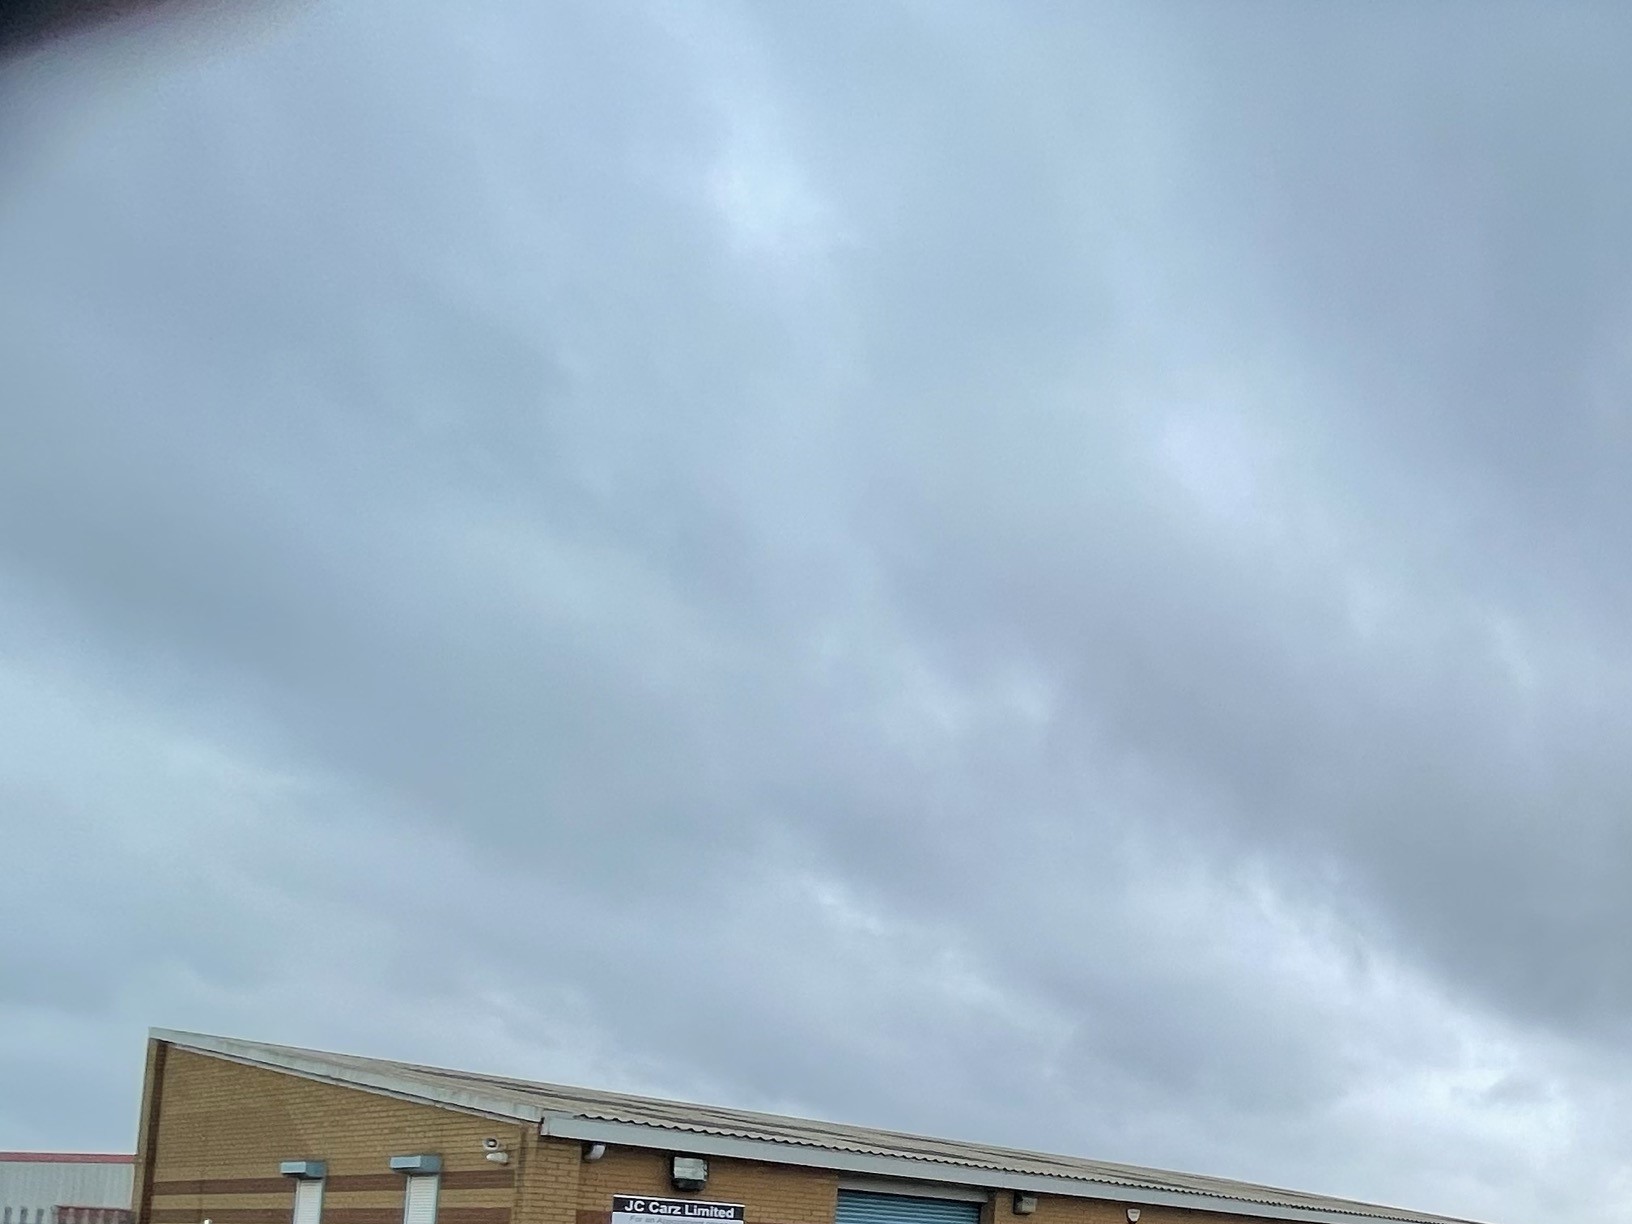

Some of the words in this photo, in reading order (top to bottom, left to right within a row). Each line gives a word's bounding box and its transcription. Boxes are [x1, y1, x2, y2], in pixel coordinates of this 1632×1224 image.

[624, 1200, 645, 1212] JC
[648, 1201, 682, 1215] Carz
[685, 1204, 735, 1219] Limited
